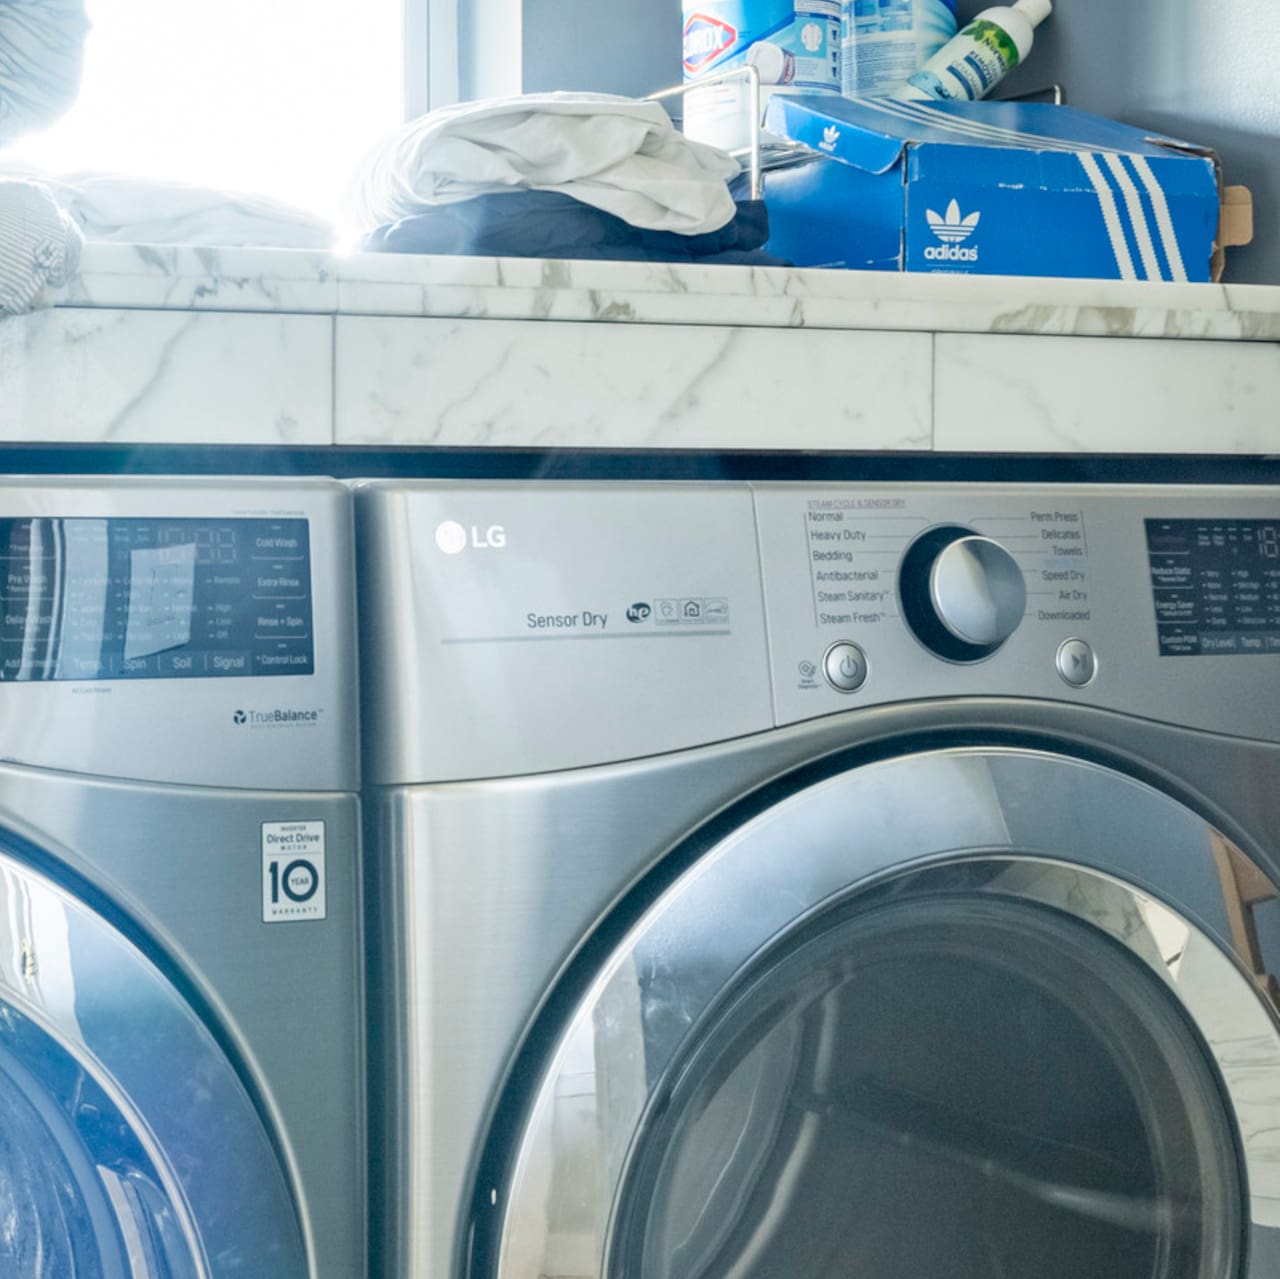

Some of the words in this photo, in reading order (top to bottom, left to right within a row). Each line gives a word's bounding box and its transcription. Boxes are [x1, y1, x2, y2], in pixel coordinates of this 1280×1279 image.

[923, 245, 979, 261] adidas
[808, 512, 843, 521] Normal
[471, 526, 506, 548] LG
[811, 530, 841, 541] Heavy
[844, 529, 866, 541] Duty
[813, 551, 853, 562] Bedding
[816, 571, 879, 580] Antibacterial
[818, 592, 846, 601] Steam
[527, 614, 578, 628] Sensor
[583, 611, 608, 628] Dry
[820, 613, 852, 624] Steam
[173, 656, 193, 669] Soil
[213, 655, 245, 670] Signal
[248, 709, 318, 722] TrueBalance
[267, 833, 294, 844] Direct
[295, 832, 320, 843] Drive
[269, 858, 319, 904] 10
[291, 877, 310, 886] YEAR
